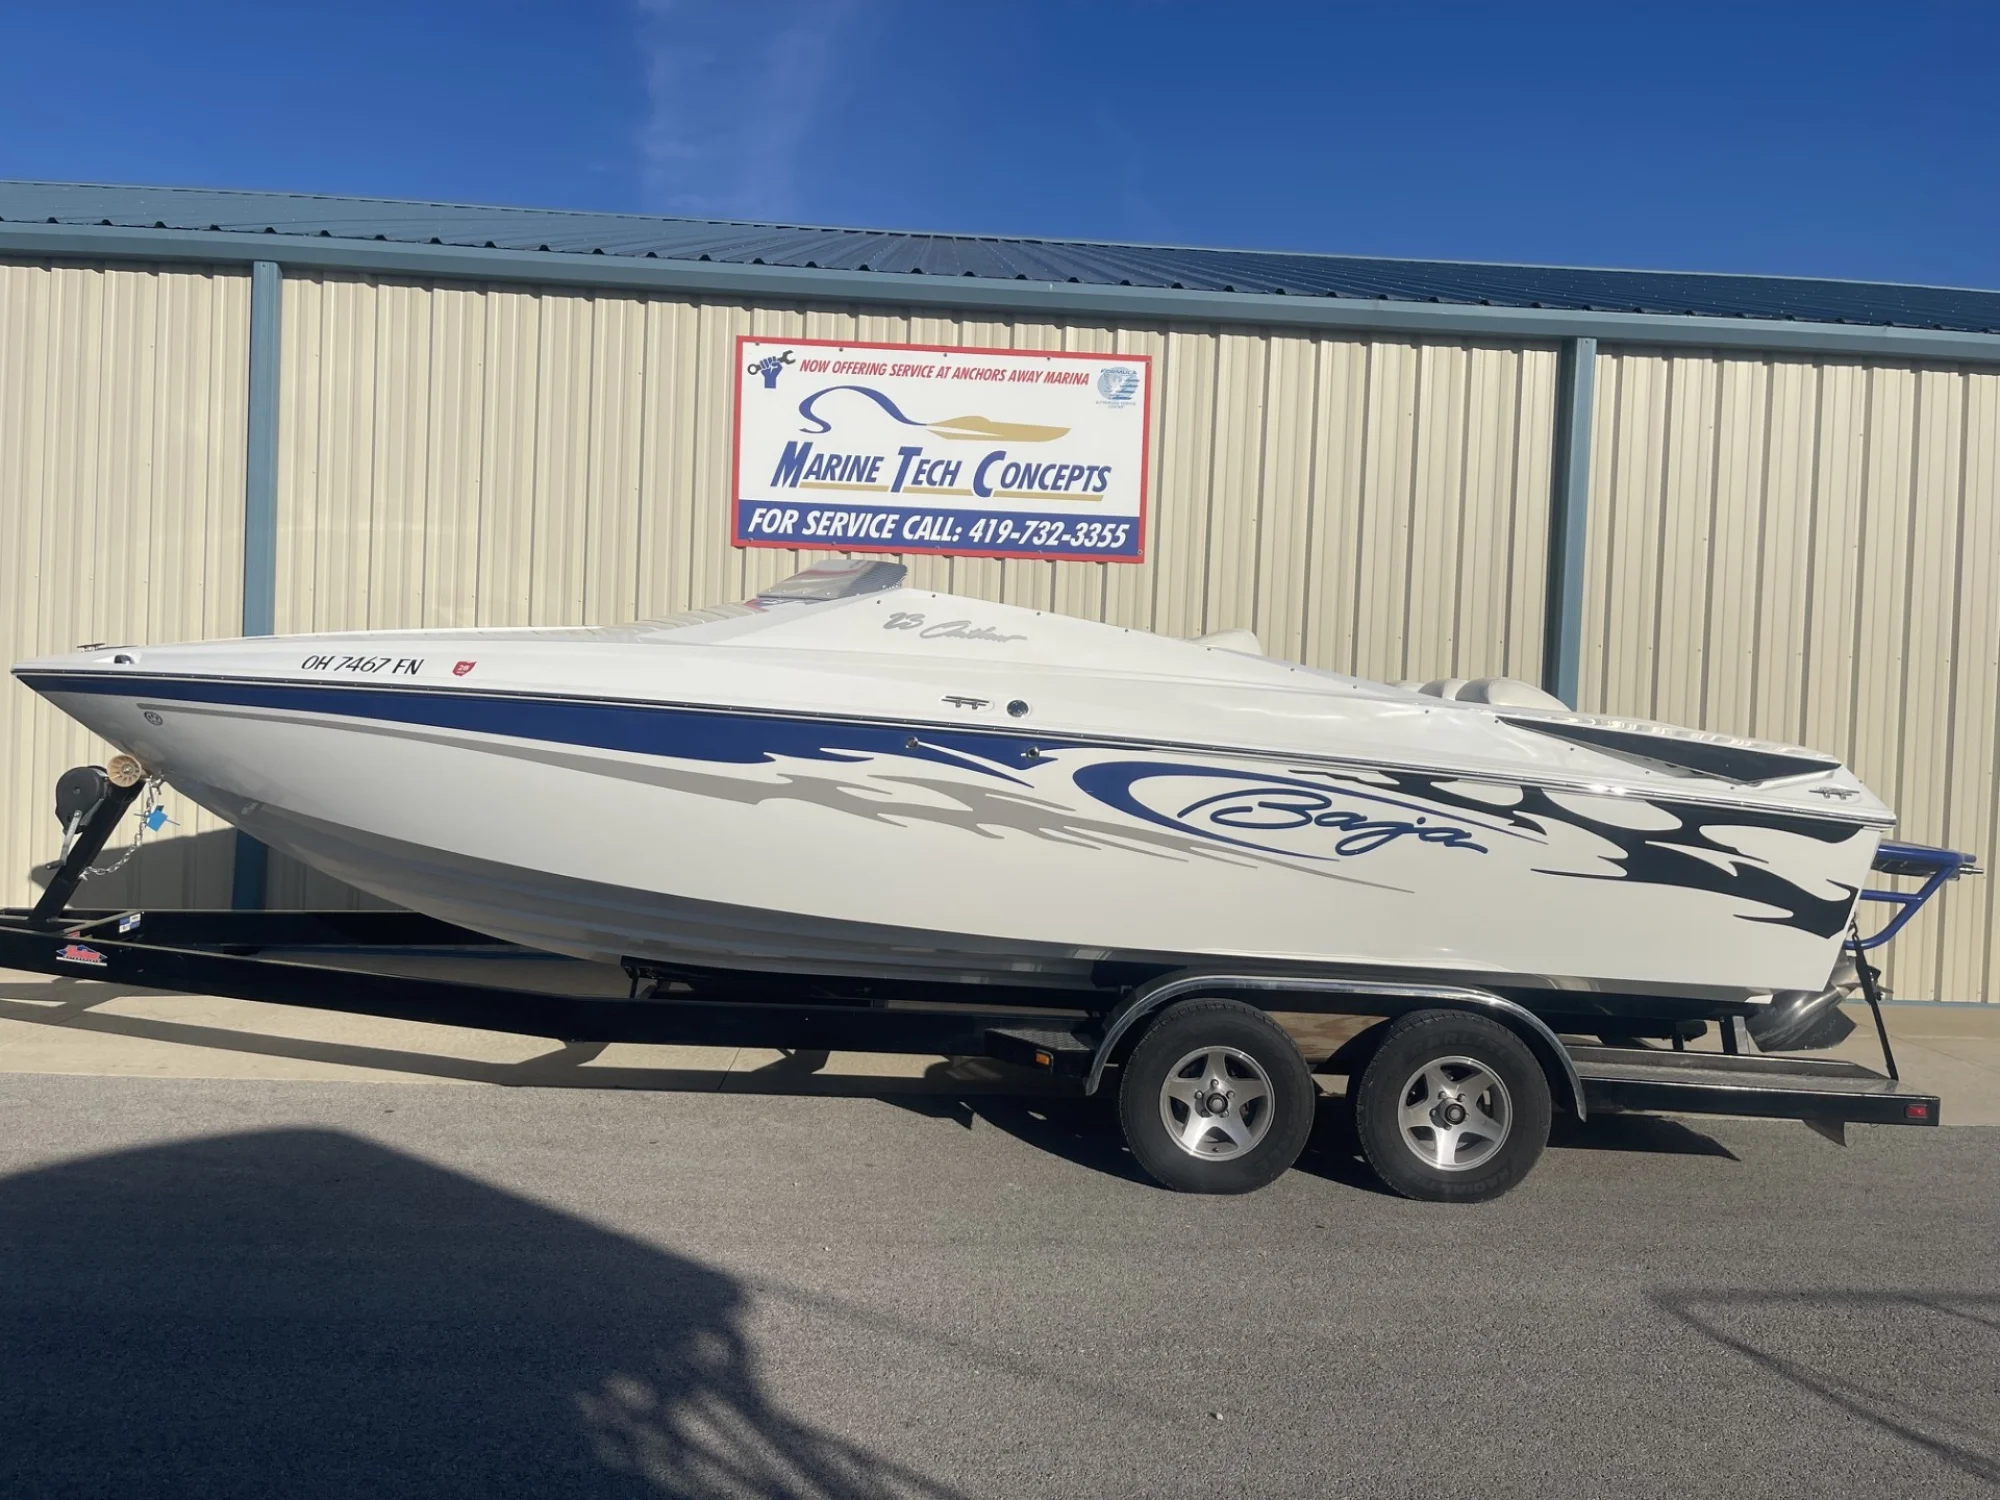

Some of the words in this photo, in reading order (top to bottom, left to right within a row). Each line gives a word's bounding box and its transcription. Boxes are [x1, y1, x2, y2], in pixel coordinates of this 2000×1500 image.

[800, 359, 831, 373] NOW
[832, 361, 887, 376] OFFERING
[889, 363, 935, 379] SERVICE
[936, 366, 951, 379] AT
[952, 367, 1007, 382] ANCHORS
[1008, 369, 1043, 383] AWAY
[1043, 371, 1090, 386] MARINA
[770, 440, 884, 488] MARINE
[890, 446, 963, 493] TECH
[973, 450, 1112, 498] CONCEPTS
[748, 507, 799, 534] FOR
[801, 510, 900, 539] SERVICE
[902, 514, 963, 542] CALL:
[968, 518, 1130, 548] 419-732-3355
[301, 655, 336, 670] OH
[334, 656, 392, 673] 7467
[392, 658, 425, 675] FN
[1177, 788, 1489, 856] Baja
